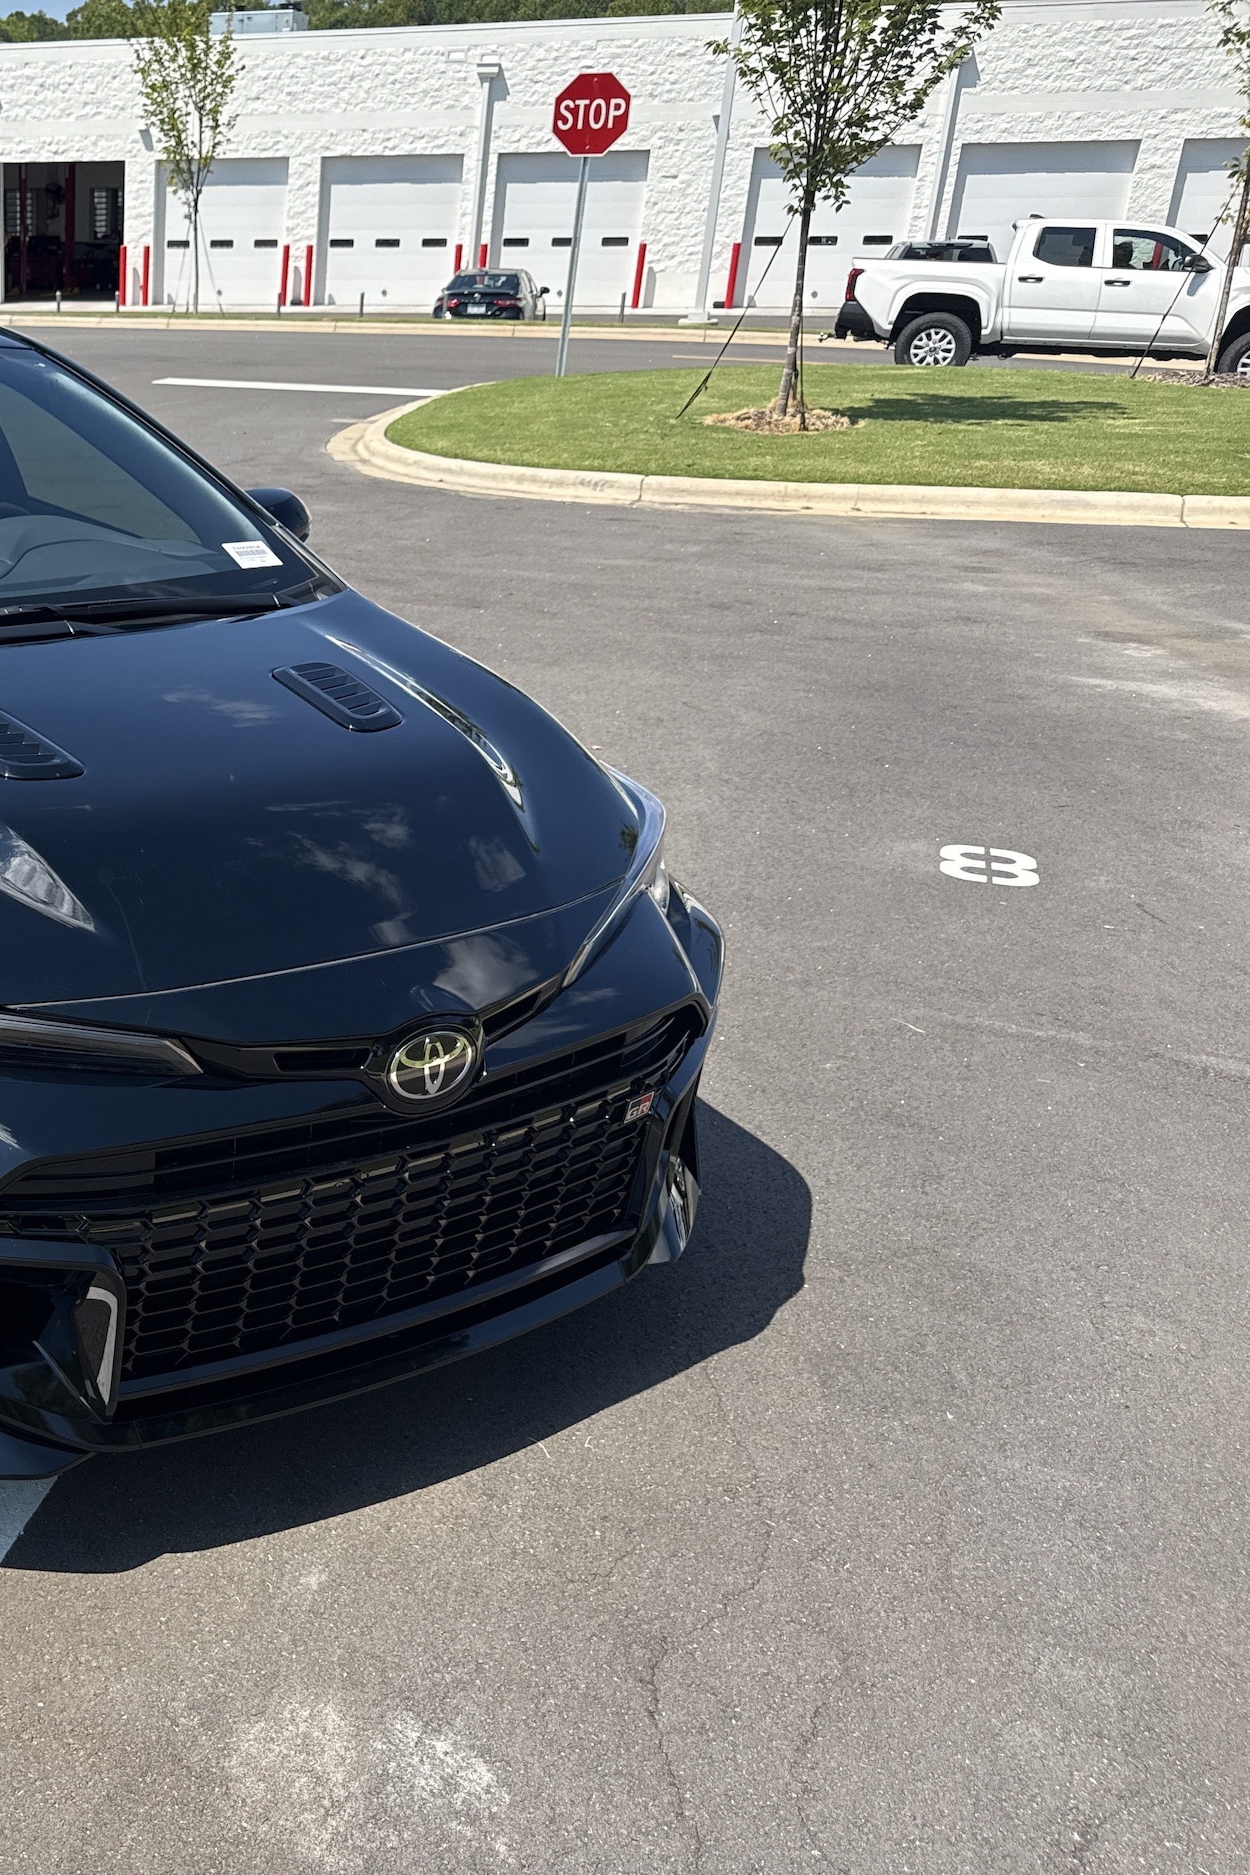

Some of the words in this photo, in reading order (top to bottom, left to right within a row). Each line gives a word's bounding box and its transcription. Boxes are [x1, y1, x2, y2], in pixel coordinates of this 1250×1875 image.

[557, 98, 626, 131] STOP
[939, 844, 1040, 887] 8
[627, 1101, 650, 1120] GR
